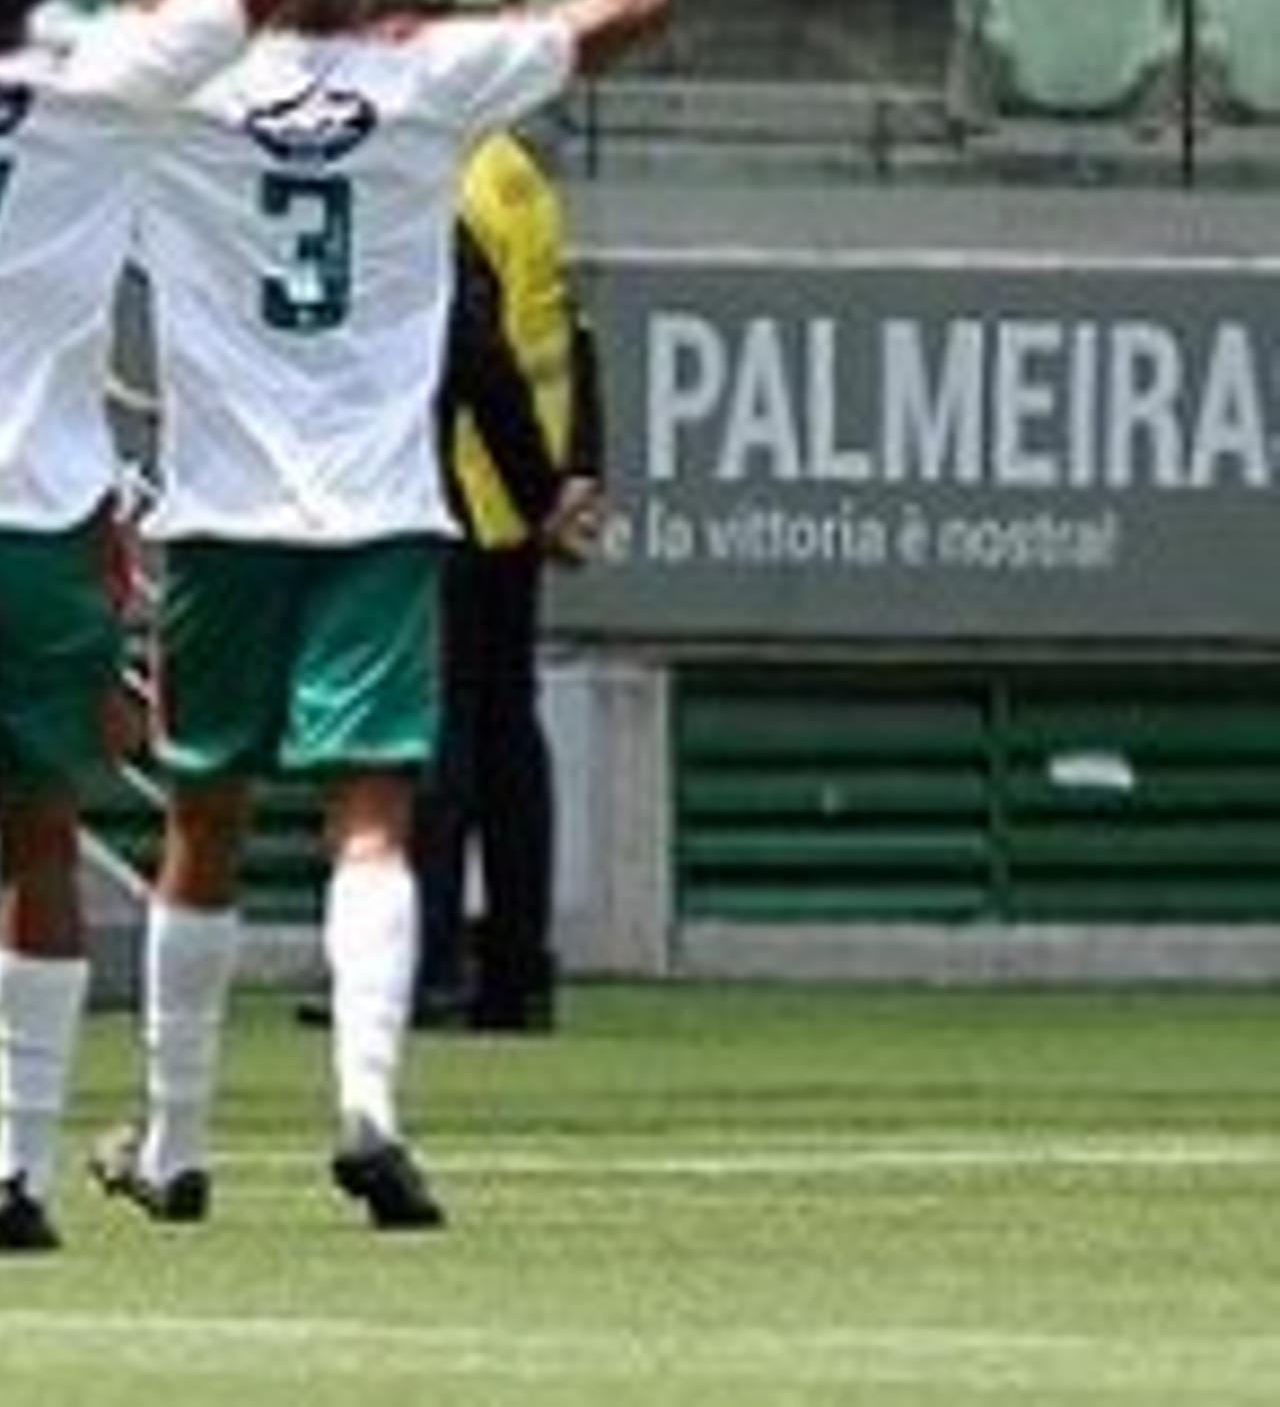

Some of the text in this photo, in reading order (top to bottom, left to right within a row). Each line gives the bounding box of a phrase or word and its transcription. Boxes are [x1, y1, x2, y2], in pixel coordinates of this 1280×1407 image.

[260, 171, 354, 331] 3
[648, 317, 1280, 489] PALMEIRA
[646, 499, 695, 563] la
[704, 501, 887, 565] vittoria
